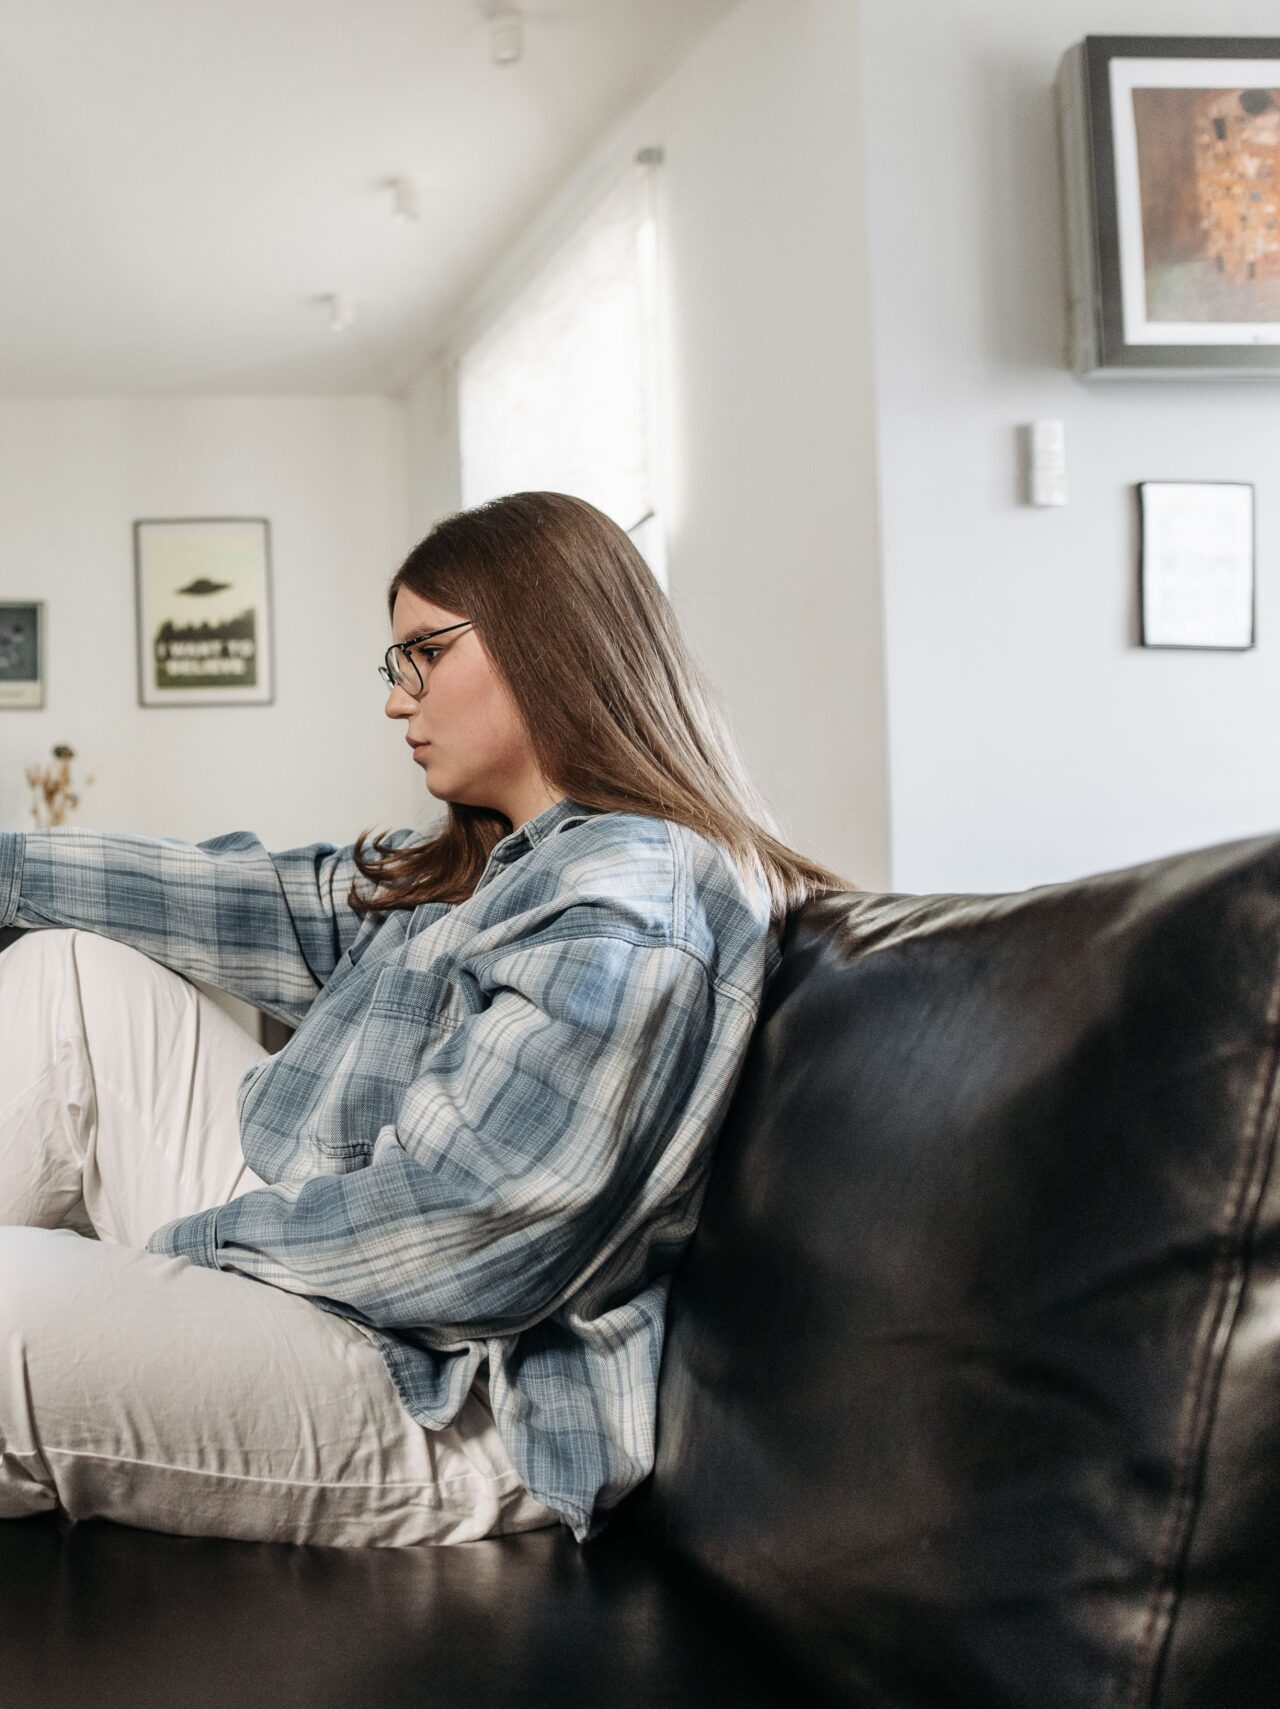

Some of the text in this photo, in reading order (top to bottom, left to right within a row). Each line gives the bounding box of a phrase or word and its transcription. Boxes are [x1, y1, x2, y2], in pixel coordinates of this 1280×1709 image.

[170, 639, 222, 658] WANT
[227, 638, 255, 658] TO
[166, 658, 245, 675] BELIEVE
